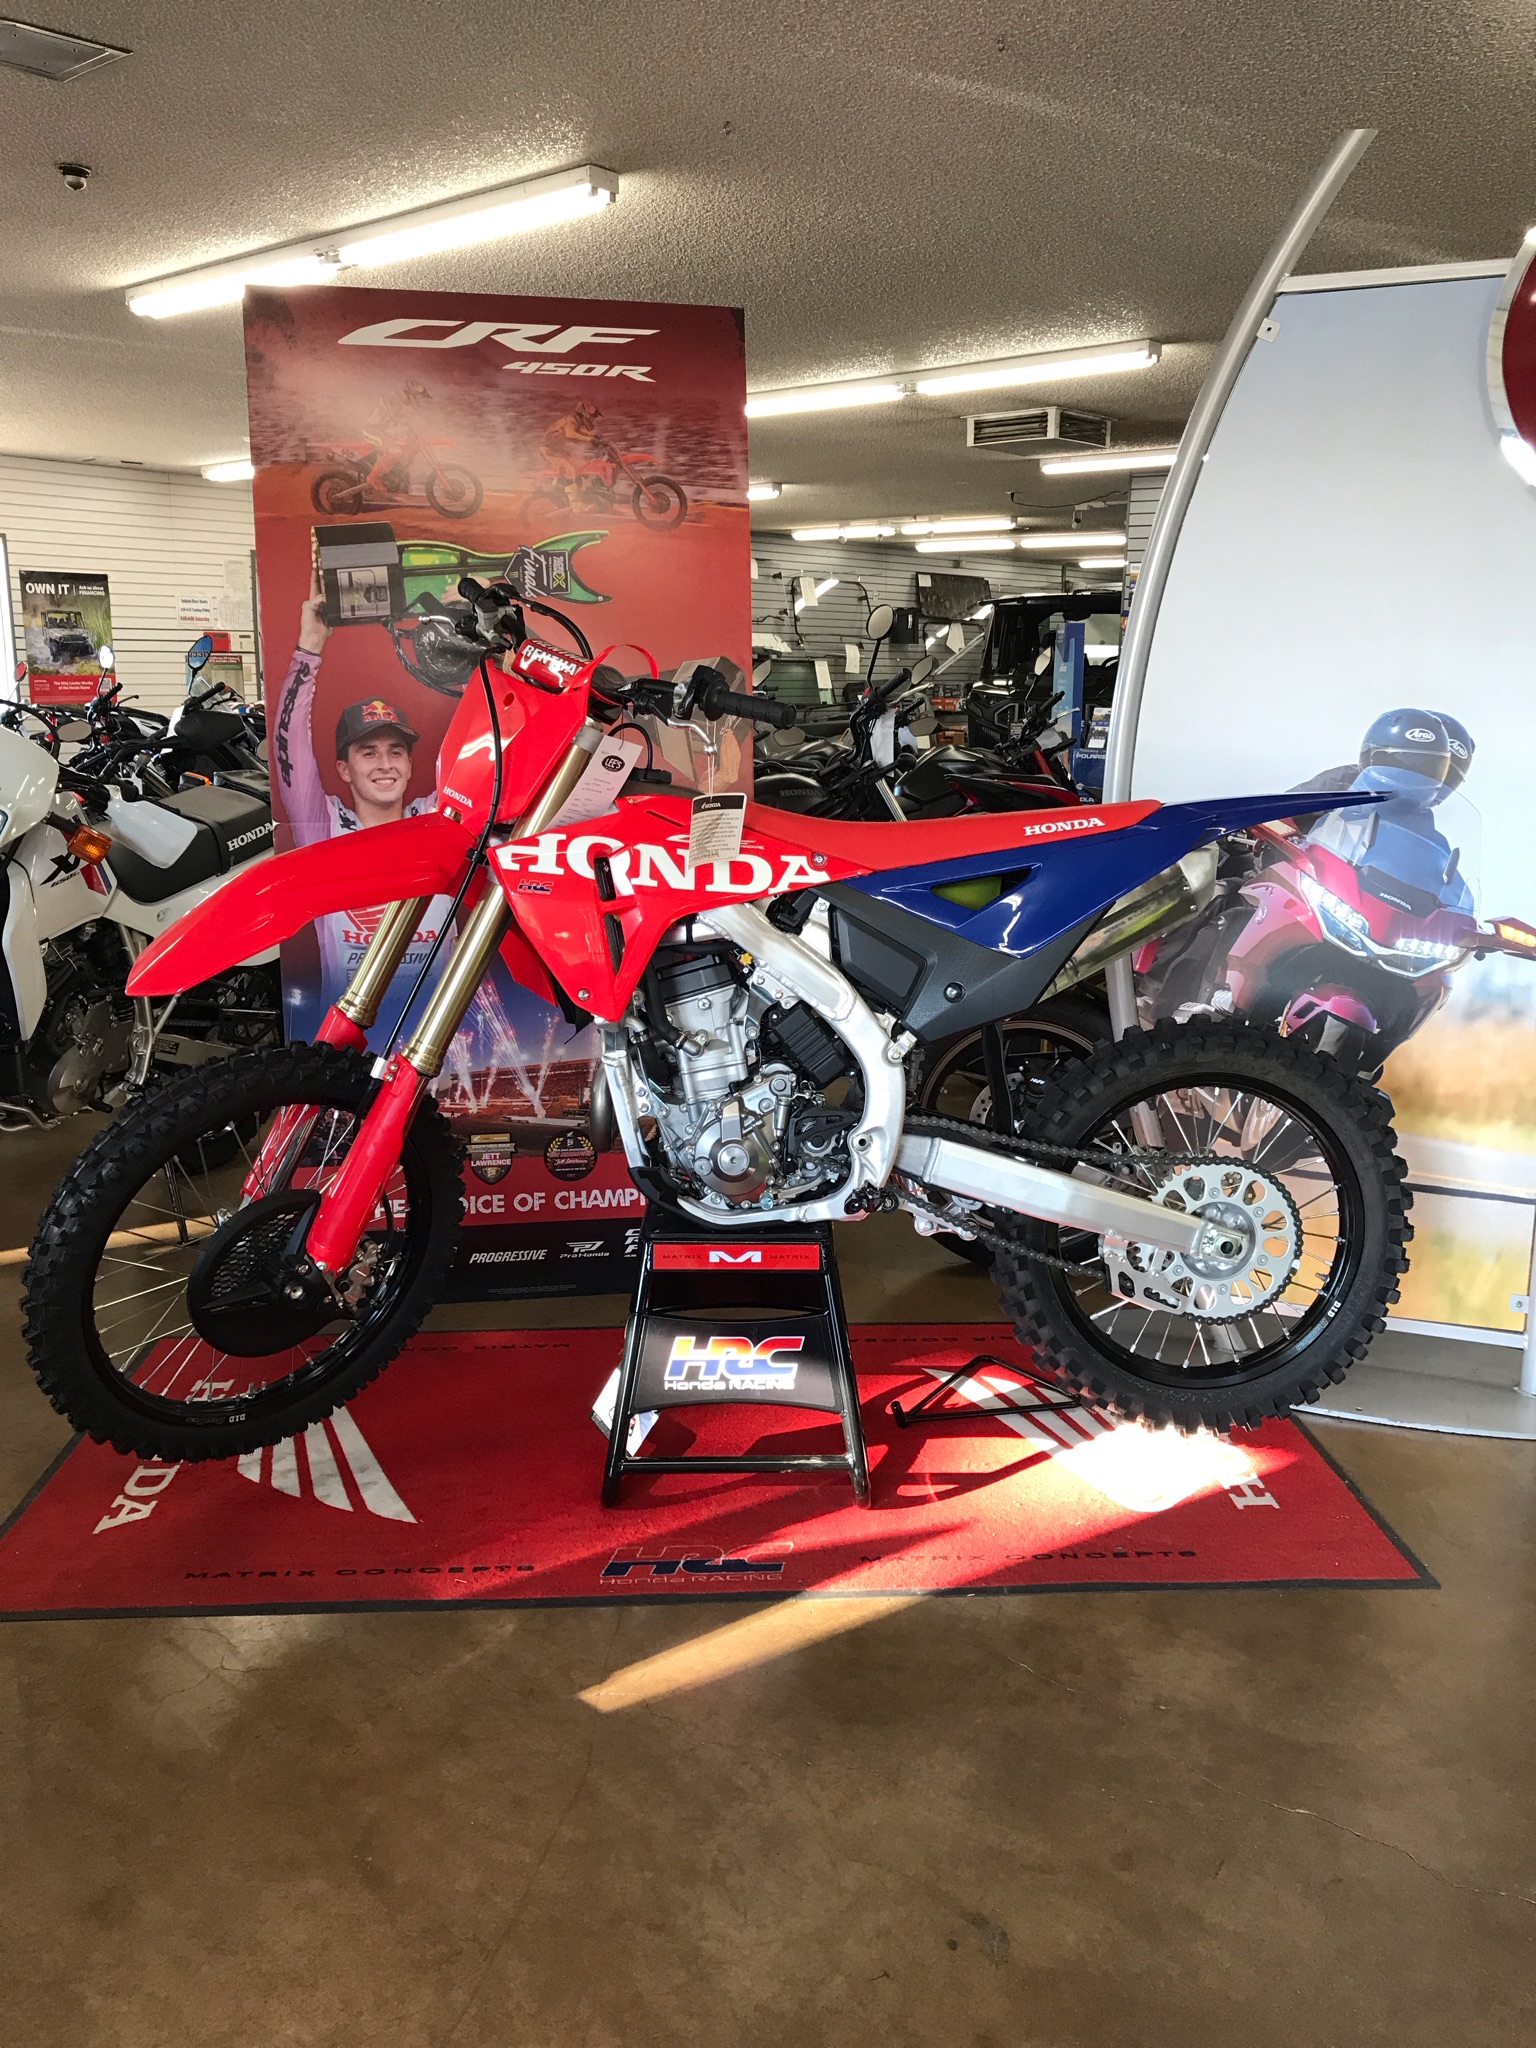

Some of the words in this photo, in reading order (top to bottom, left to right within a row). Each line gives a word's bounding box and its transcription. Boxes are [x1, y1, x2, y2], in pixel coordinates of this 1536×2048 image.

[338, 319, 661, 353] CRF
[502, 361, 656, 382] 450R
[518, 546, 547, 598] Finals
[25, 583, 56, 594] OWN
[58, 584, 70, 595] IT
[1411, 730, 1433, 739] Arai
[443, 786, 473, 808] HONDA
[780, 789, 821, 798] HONDA
[227, 820, 274, 851] HONDA
[1023, 817, 1106, 836] HONDA
[495, 834, 831, 895] HONDA
[518, 878, 554, 893] HRC
[1379, 892, 1412, 911] HONDA
[470, 1158, 512, 1167] LAWRENCE
[513, 1192, 546, 1213] OF
[469, 1249, 548, 1264] PROGRESSIVE
[664, 1336, 805, 1380] HRC
[664, 1380, 726, 1390] Honda
[729, 1379, 795, 1390] RACING
[602, 1542, 794, 1577] HRC
[1005, 1550, 1197, 1560] CONCEPTS
[184, 1570, 315, 1579] MATRIX
[335, 1564, 535, 1576] CONCEPTS
[600, 1575, 685, 1585] Honda
[692, 1573, 783, 1583] RACING
